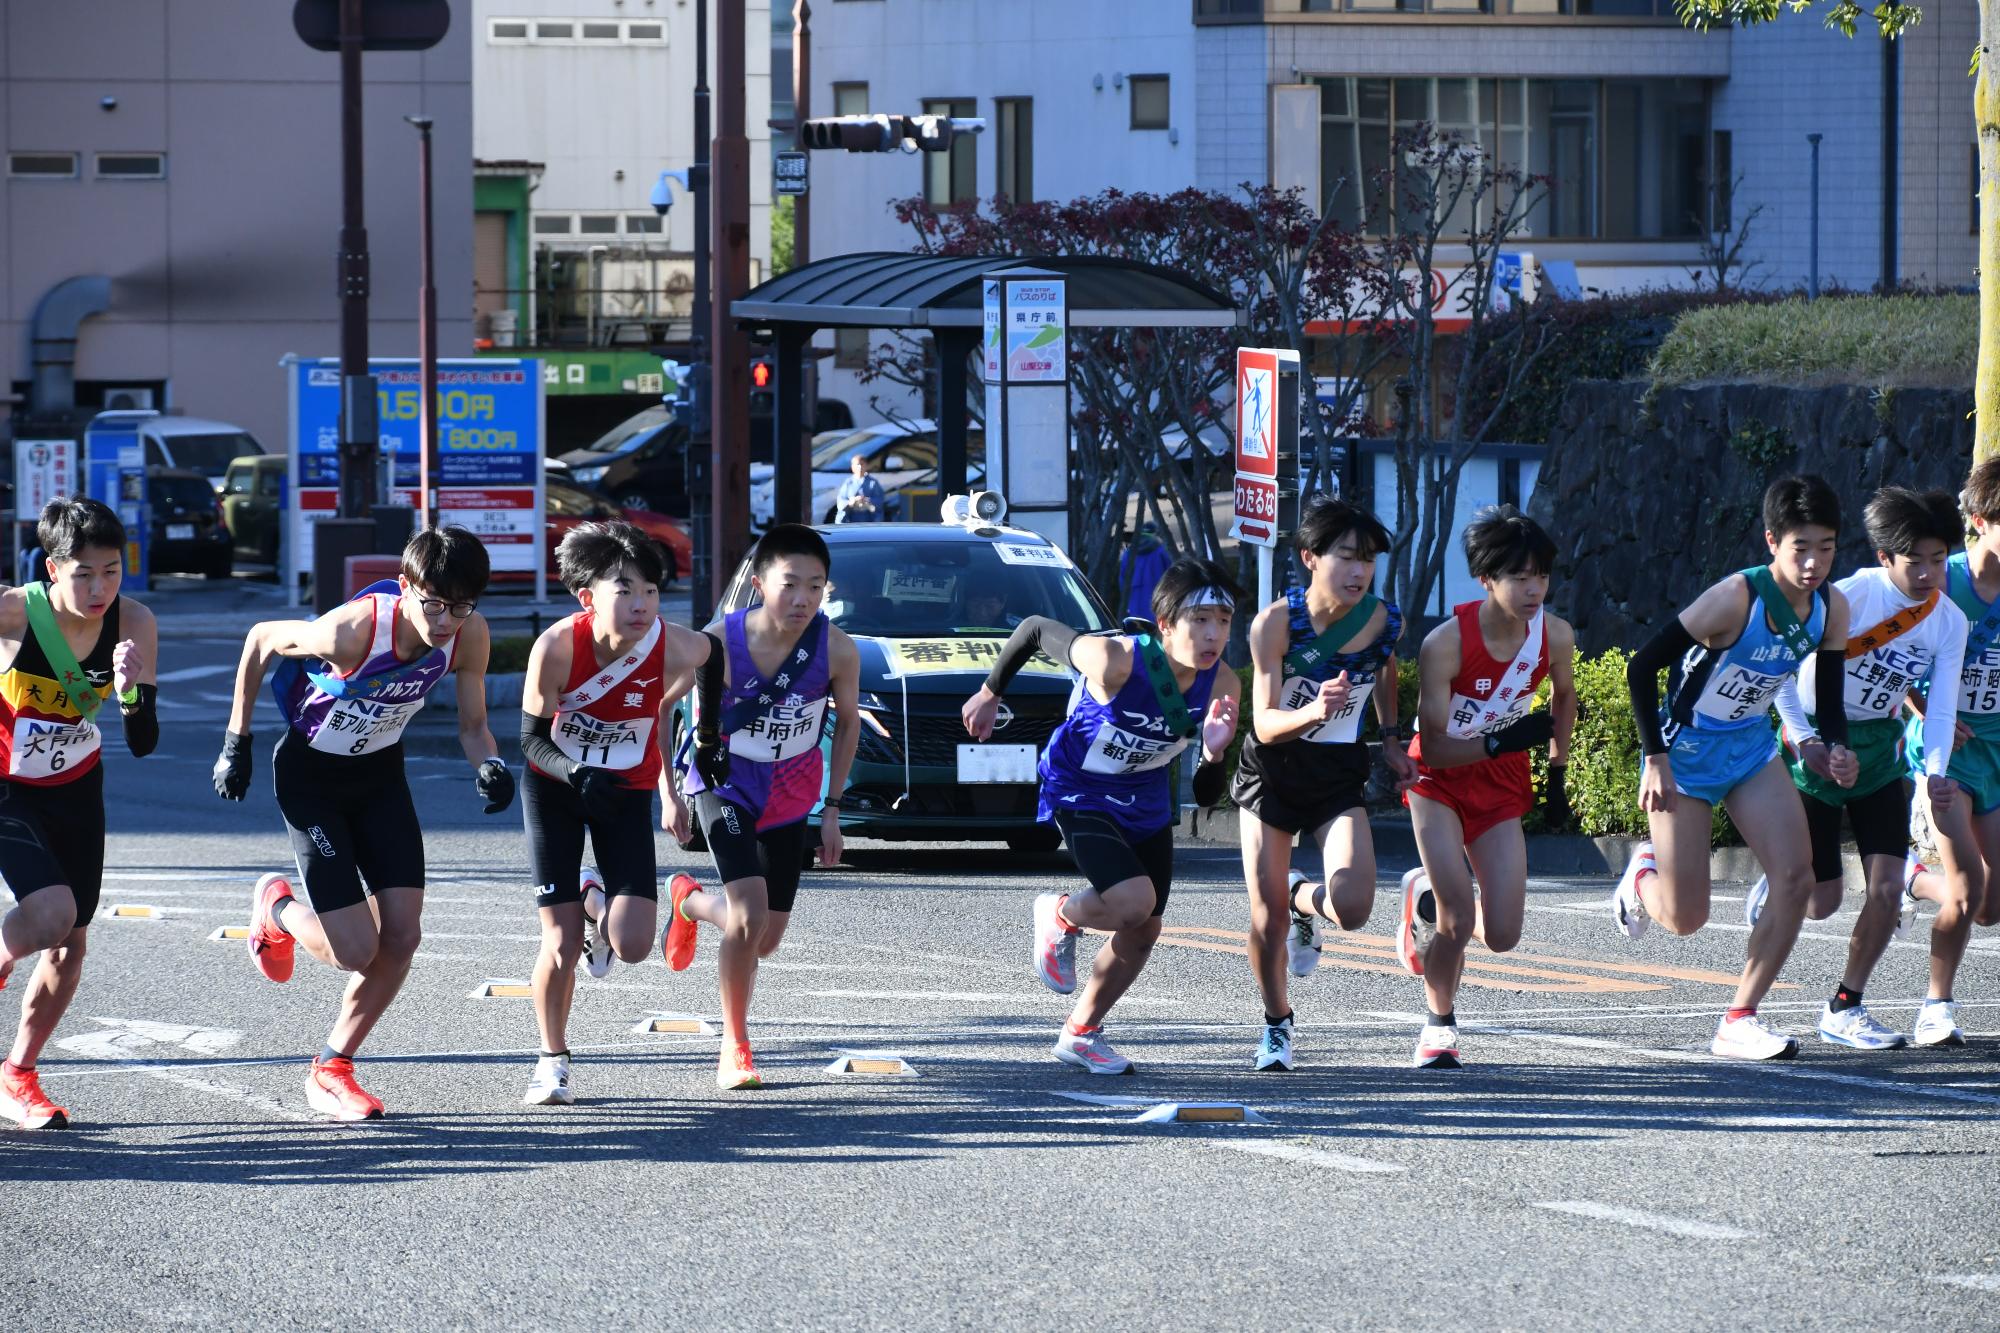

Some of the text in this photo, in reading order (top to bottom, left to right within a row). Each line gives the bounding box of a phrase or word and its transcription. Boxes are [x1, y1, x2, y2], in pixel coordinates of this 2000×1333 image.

[1015, 292, 1057, 301] バスのりば
[1016, 312, 1056, 323] 県庁前
[544, 364, 585, 384] 出口
[376, 390, 495, 421] 1,50円
[449, 428, 517, 450] 800円
[1236, 484, 1275, 516] わたるな
[900, 641, 1060, 667] 審判
[1864, 648, 1929, 676] NEC
[24, 684, 68, 709] 大月
[369, 680, 424, 698] アルプス
[1475, 678, 1492, 695] 甲
[1484, 661, 1530, 724] 甲斐市
[348, 699, 415, 719] NEC
[1859, 686, 1891, 711] 18
[1966, 690, 1998, 711] 15
[570, 712, 639, 732] NEC
[771, 702, 816, 721] EC
[1729, 705, 1750, 720] 5
[560, 722, 637, 745] 甲斐市A
[743, 715, 815, 742] 甲府市
[350, 738, 368, 754] 8
[578, 744, 611, 765] 11
[770, 743, 783, 760] 1
[50, 750, 66, 771] 6
[720, 805, 741, 835] 2XU
[308, 825, 336, 857] 2XU
